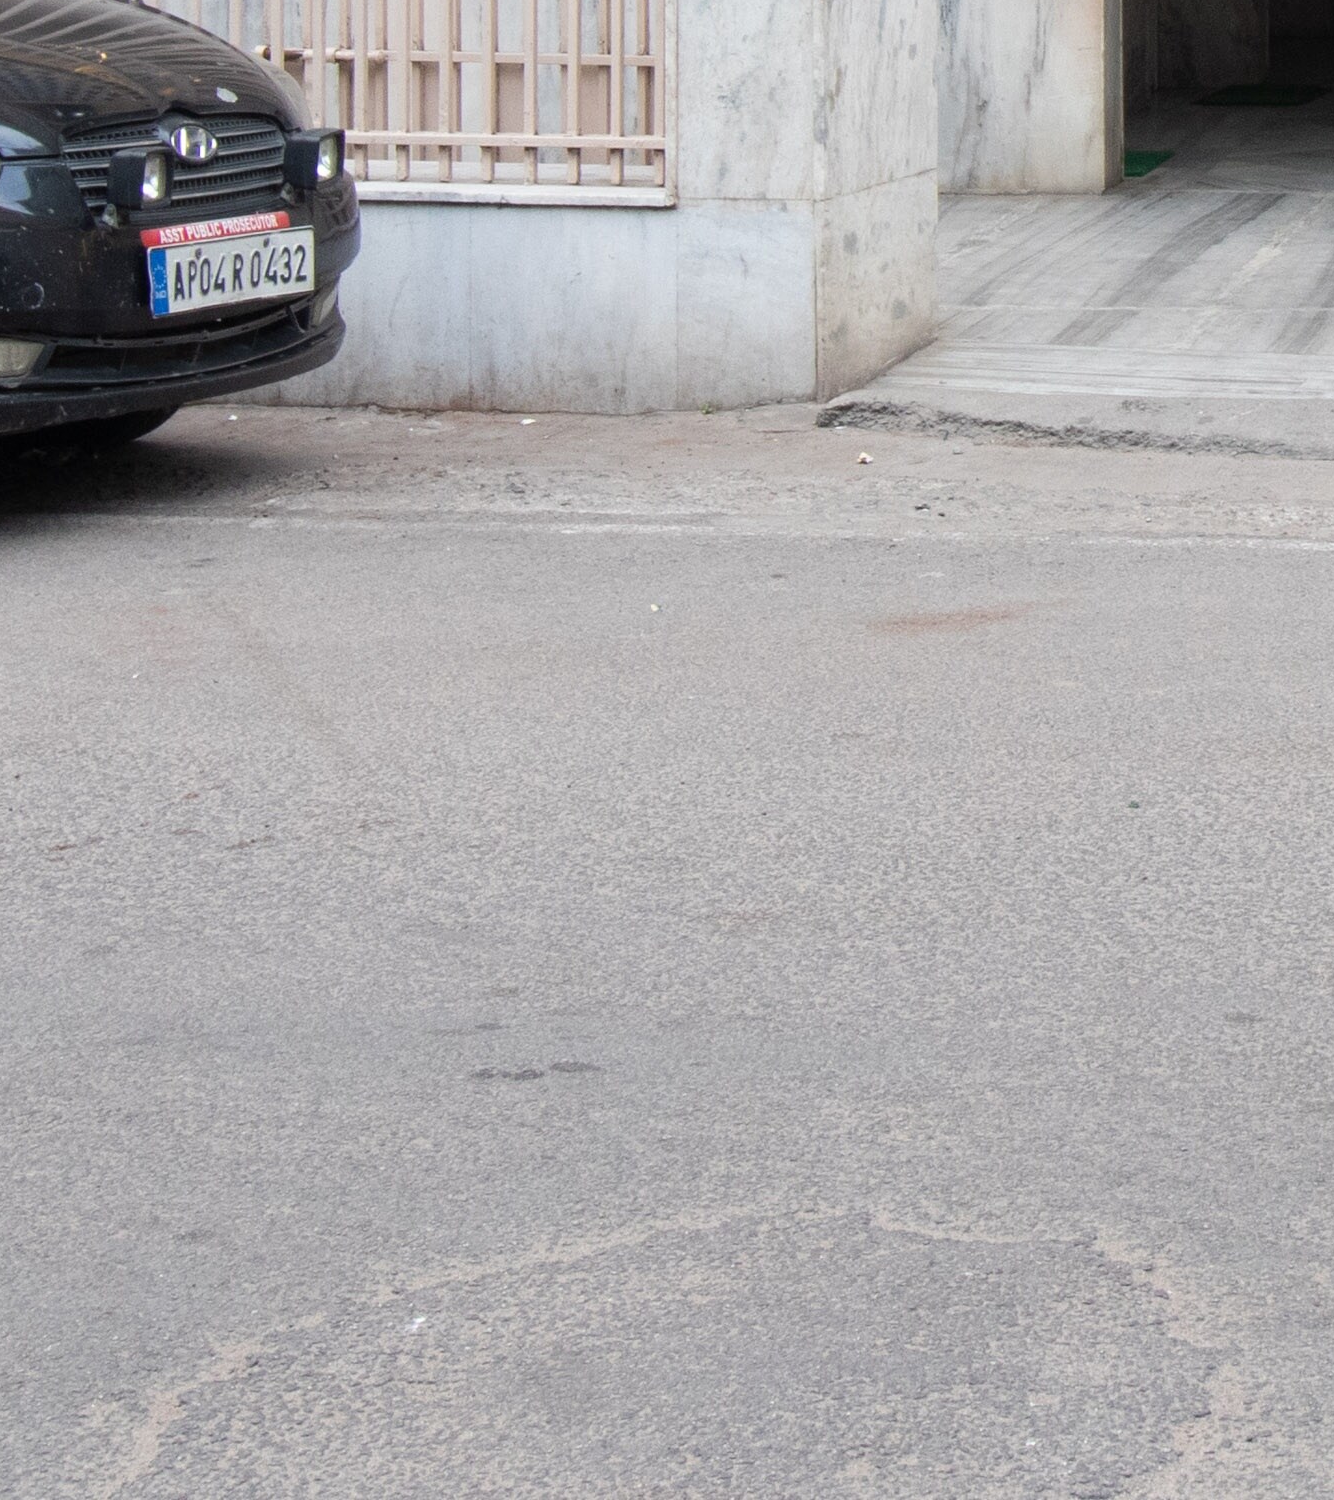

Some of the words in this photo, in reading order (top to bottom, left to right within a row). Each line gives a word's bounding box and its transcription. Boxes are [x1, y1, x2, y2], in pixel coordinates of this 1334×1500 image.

[159, 228, 187, 244] ASST
[186, 221, 222, 240] PUBLIC
[223, 214, 278, 234] PROSECUTOR
[173, 254, 226, 301] AP04
[232, 250, 244, 292] R
[250, 244, 307, 288] 0432
